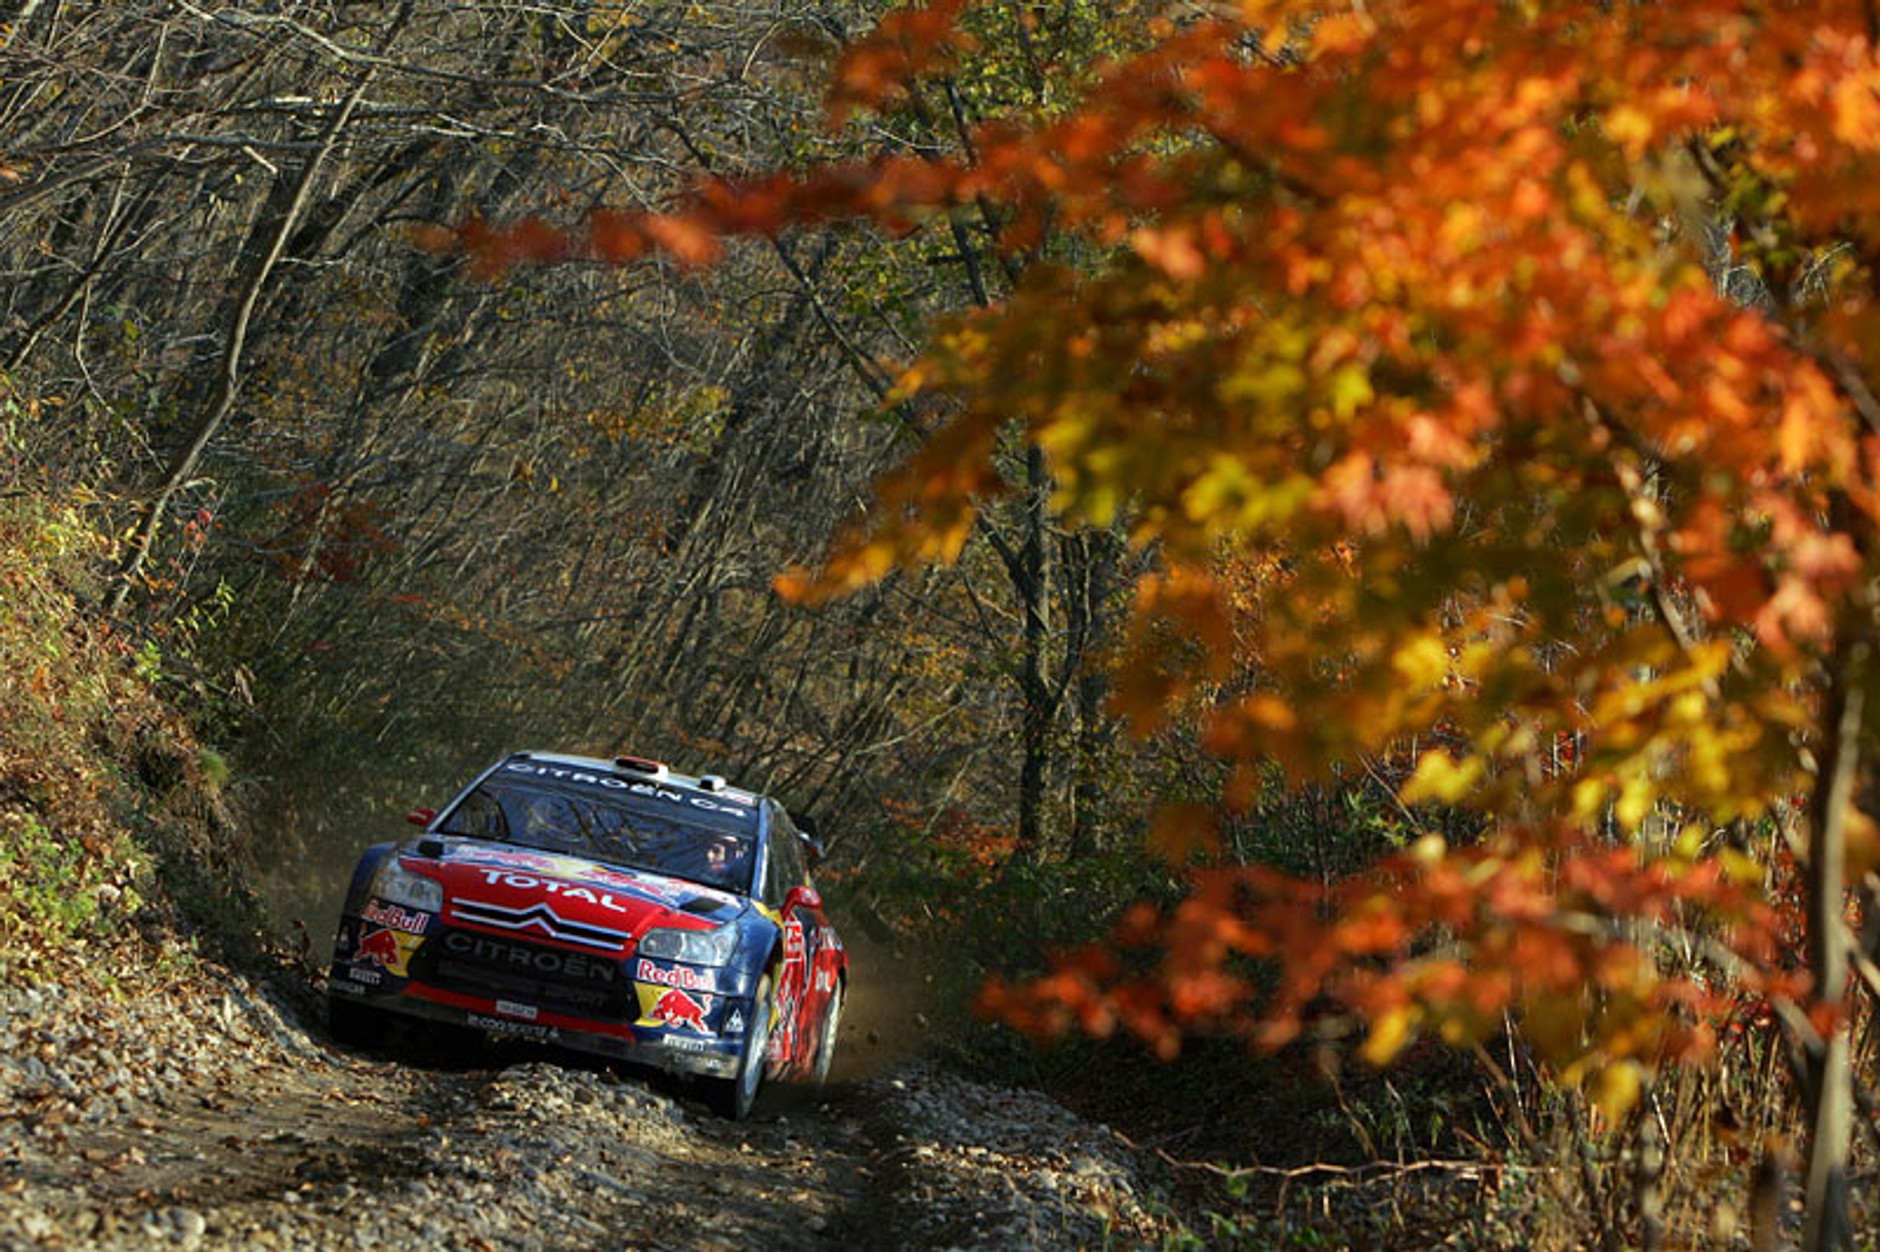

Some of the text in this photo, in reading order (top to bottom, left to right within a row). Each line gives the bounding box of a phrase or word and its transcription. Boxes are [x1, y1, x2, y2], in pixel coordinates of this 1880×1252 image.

[479, 869, 627, 913] TOTAL
[444, 932, 614, 982] CITROËN
[637, 959, 680, 988] Red
